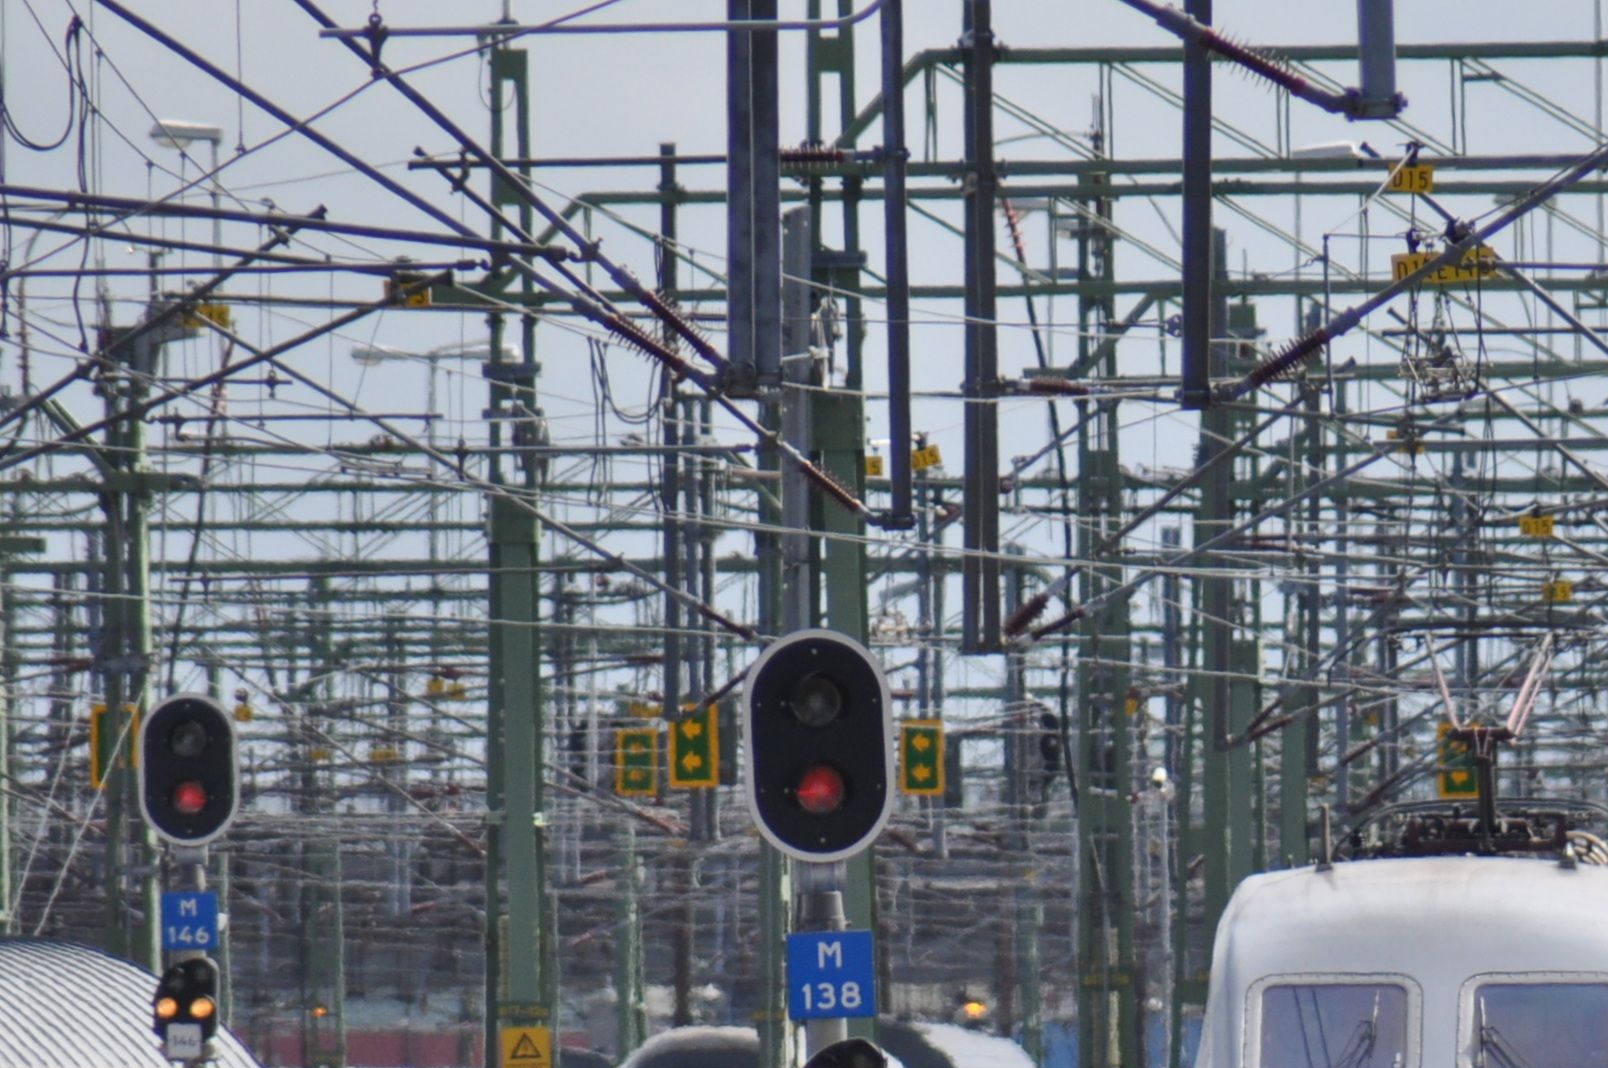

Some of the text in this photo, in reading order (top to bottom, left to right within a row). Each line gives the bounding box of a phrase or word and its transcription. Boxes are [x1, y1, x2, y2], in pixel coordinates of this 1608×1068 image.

[179, 898, 197, 917] M
[168, 926, 210, 944] 146
[817, 941, 842, 969] M
[801, 981, 862, 1011] 138
